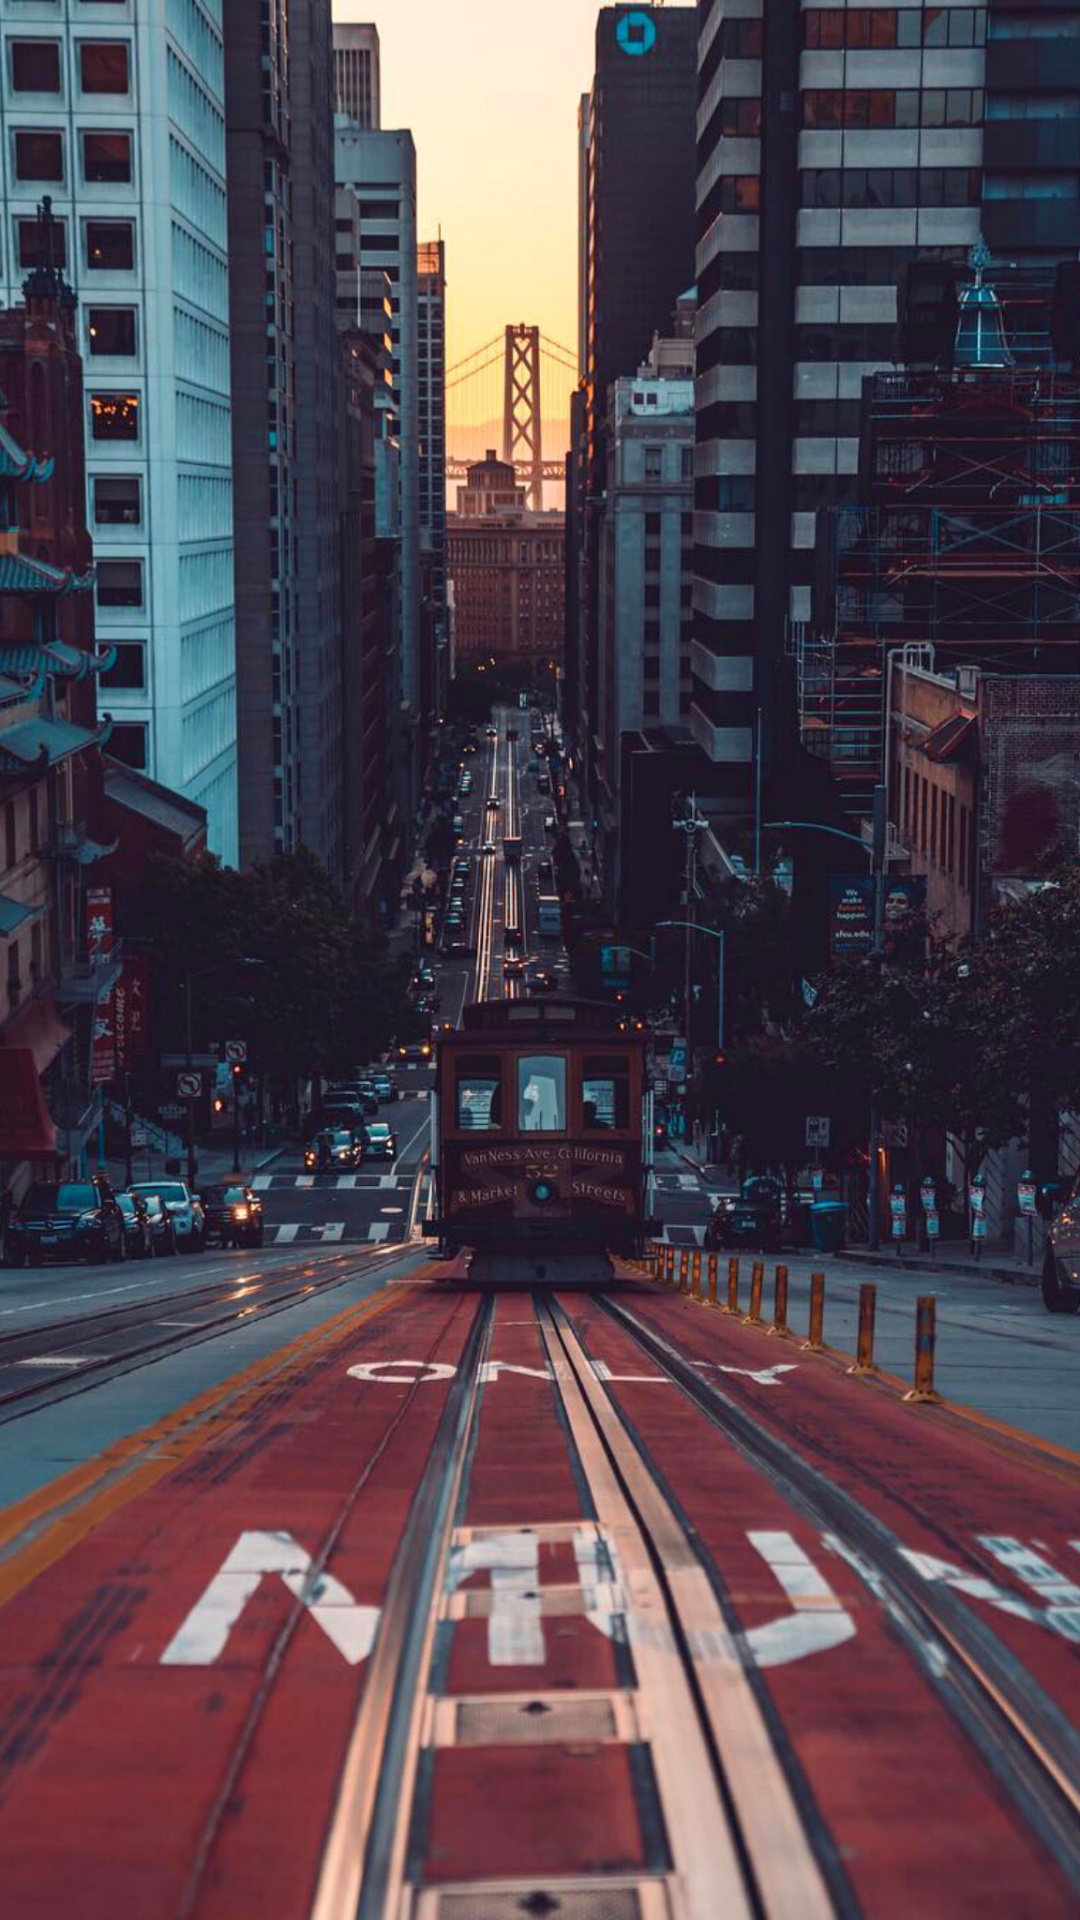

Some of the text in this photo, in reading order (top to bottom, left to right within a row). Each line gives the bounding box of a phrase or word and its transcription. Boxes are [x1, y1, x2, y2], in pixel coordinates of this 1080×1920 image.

[835, 930, 871, 938] sfsu.edu
[672, 1050, 686, 1063] P
[464, 1153, 487, 1165] Van
[488, 1149, 520, 1162] Ness
[558, 1147, 623, 1164] California
[458, 1181, 625, 1205] & Market Streets
[346, 1359, 799, 1386] ONLY
